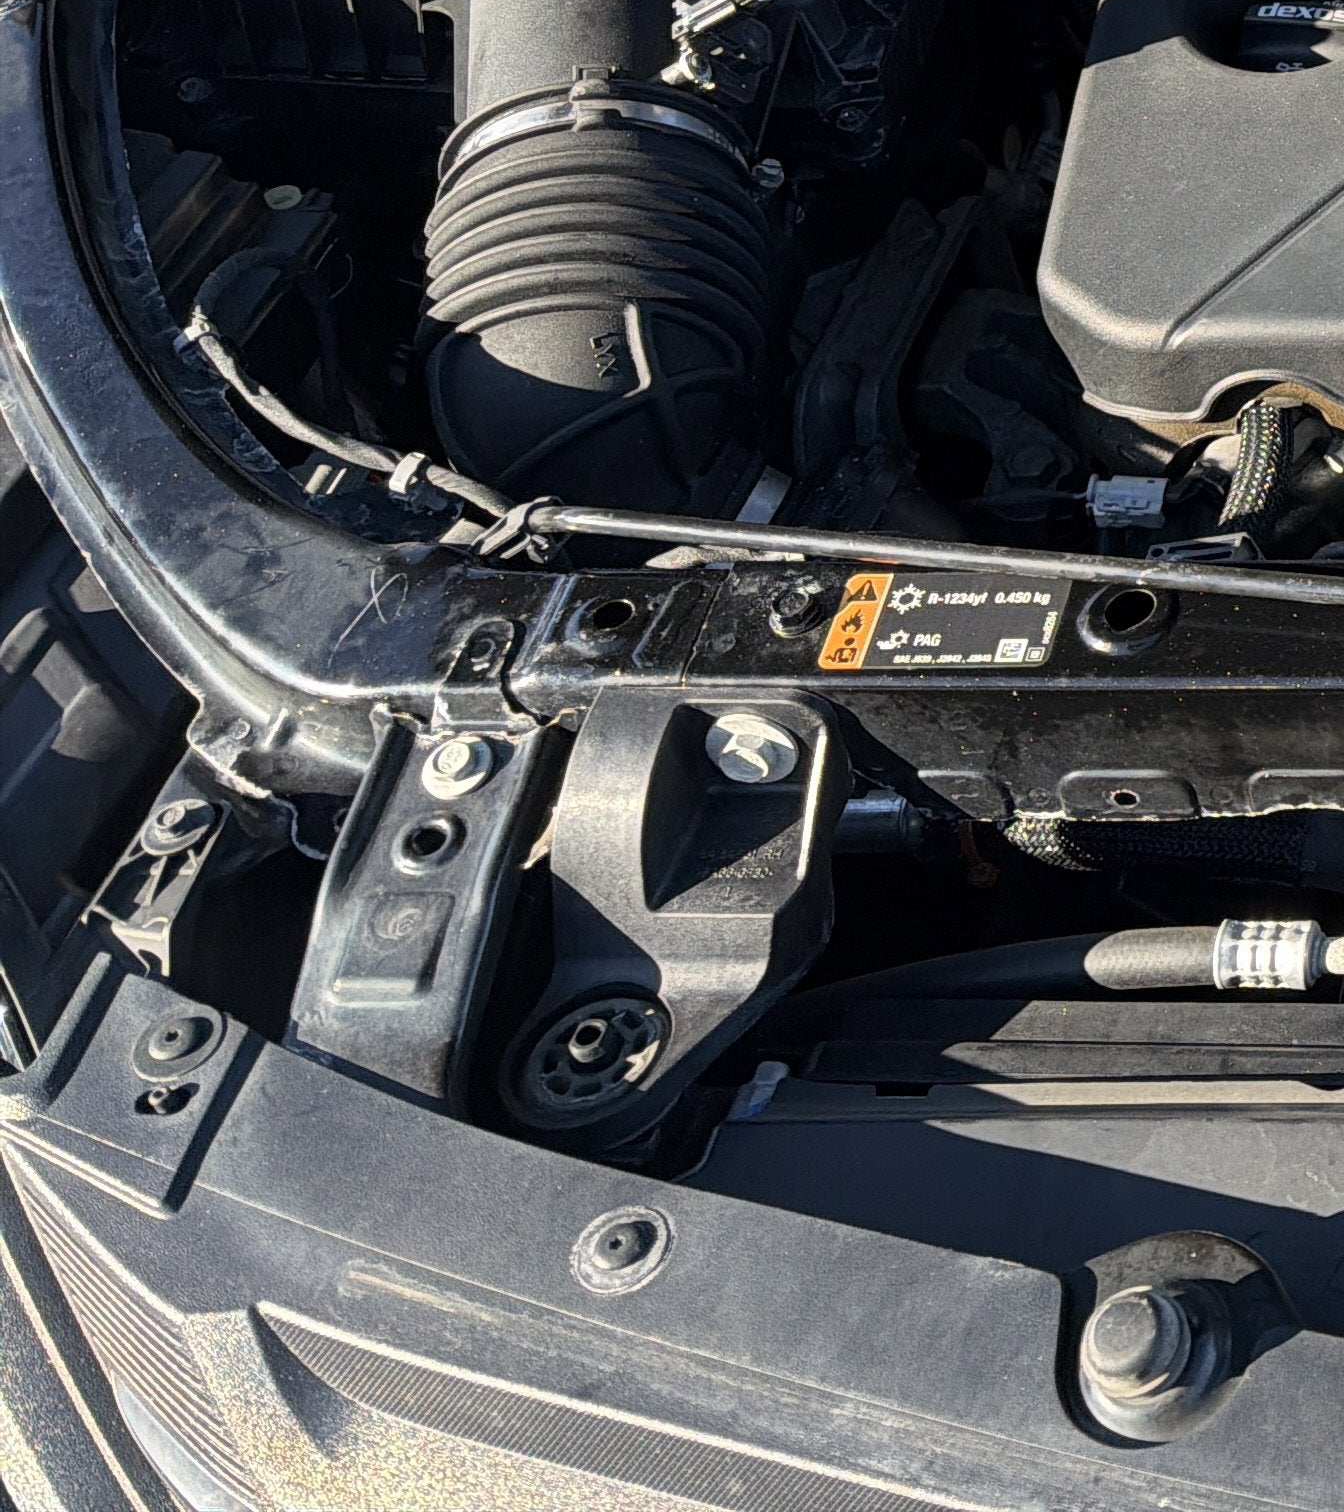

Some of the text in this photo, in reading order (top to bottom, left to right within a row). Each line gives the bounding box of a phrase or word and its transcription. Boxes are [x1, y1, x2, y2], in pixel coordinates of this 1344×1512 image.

[927, 592, 1051, 606] R-1234yf 0.450 kg
[913, 634, 942, 646] PAG
